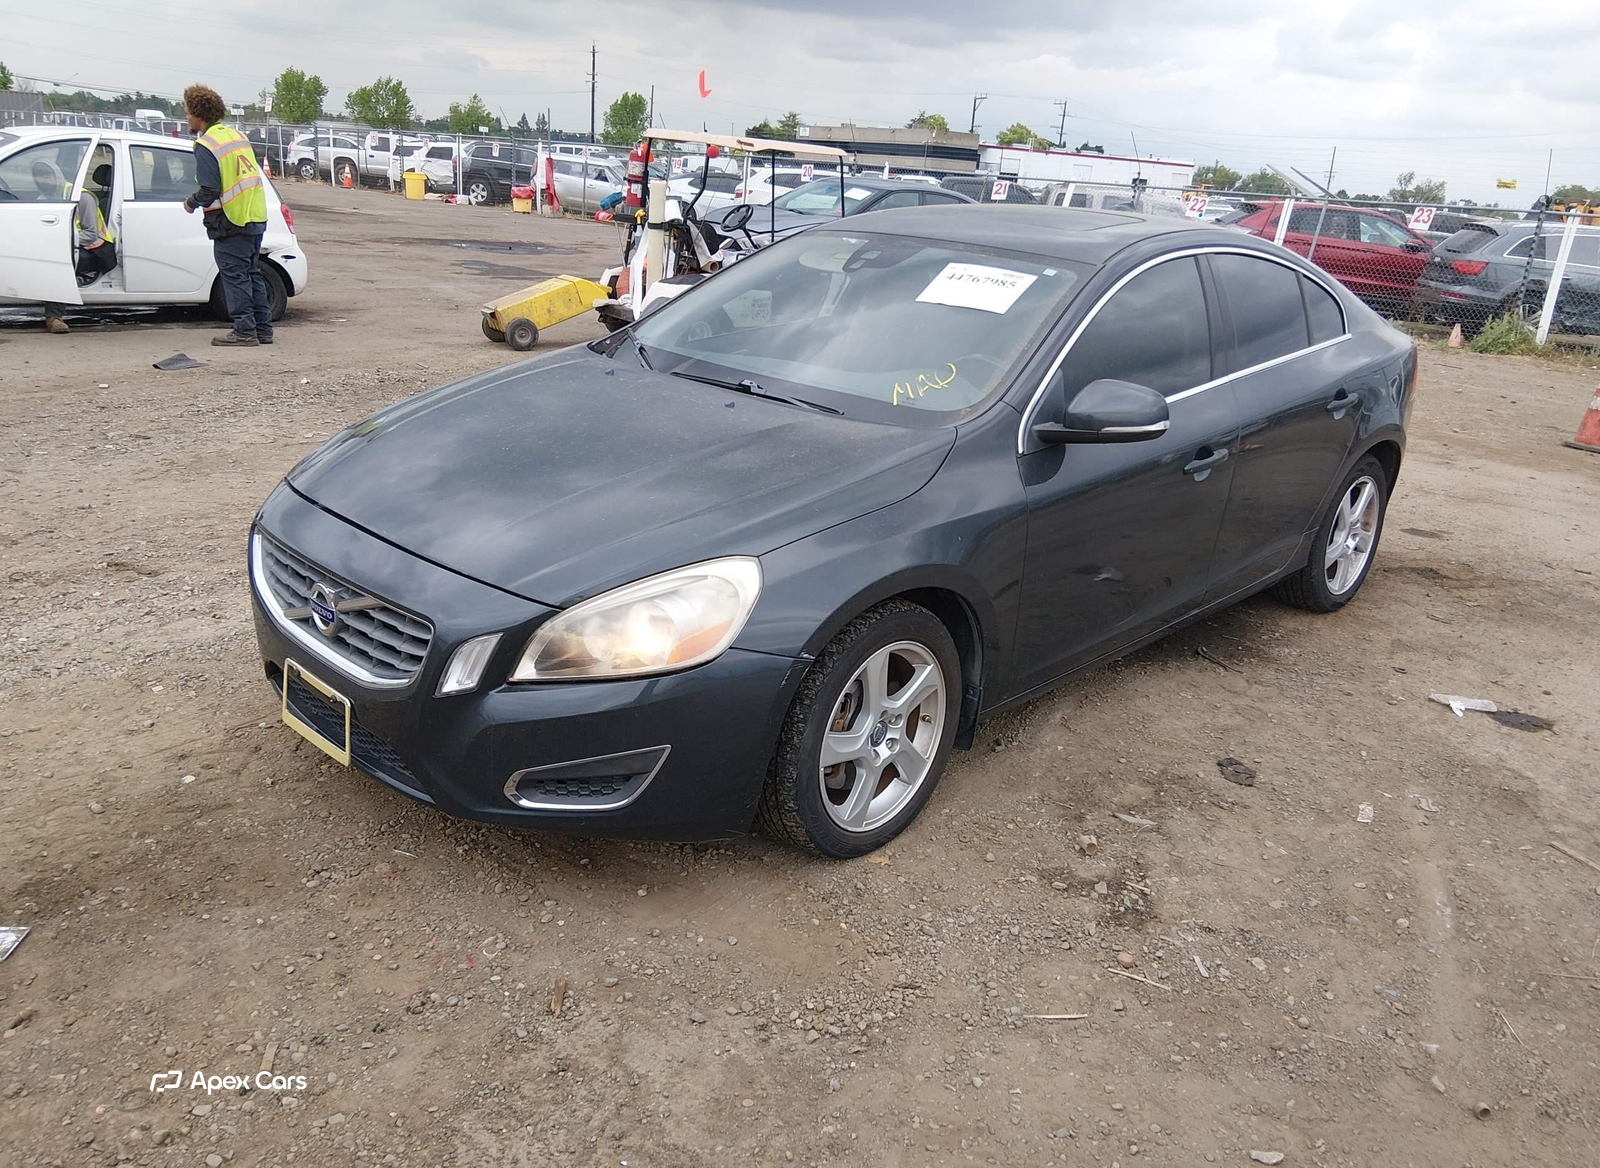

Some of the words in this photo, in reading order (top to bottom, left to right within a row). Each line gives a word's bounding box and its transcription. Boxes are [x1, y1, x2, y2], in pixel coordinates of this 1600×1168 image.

[802, 166, 813, 178] 20
[993, 182, 1008, 195] 21
[1188, 197, 1207, 213] 22
[1413, 208, 1433, 224] 23
[945, 272, 1018, 288] 44767985
[311, 602, 333, 619] VOLVO
